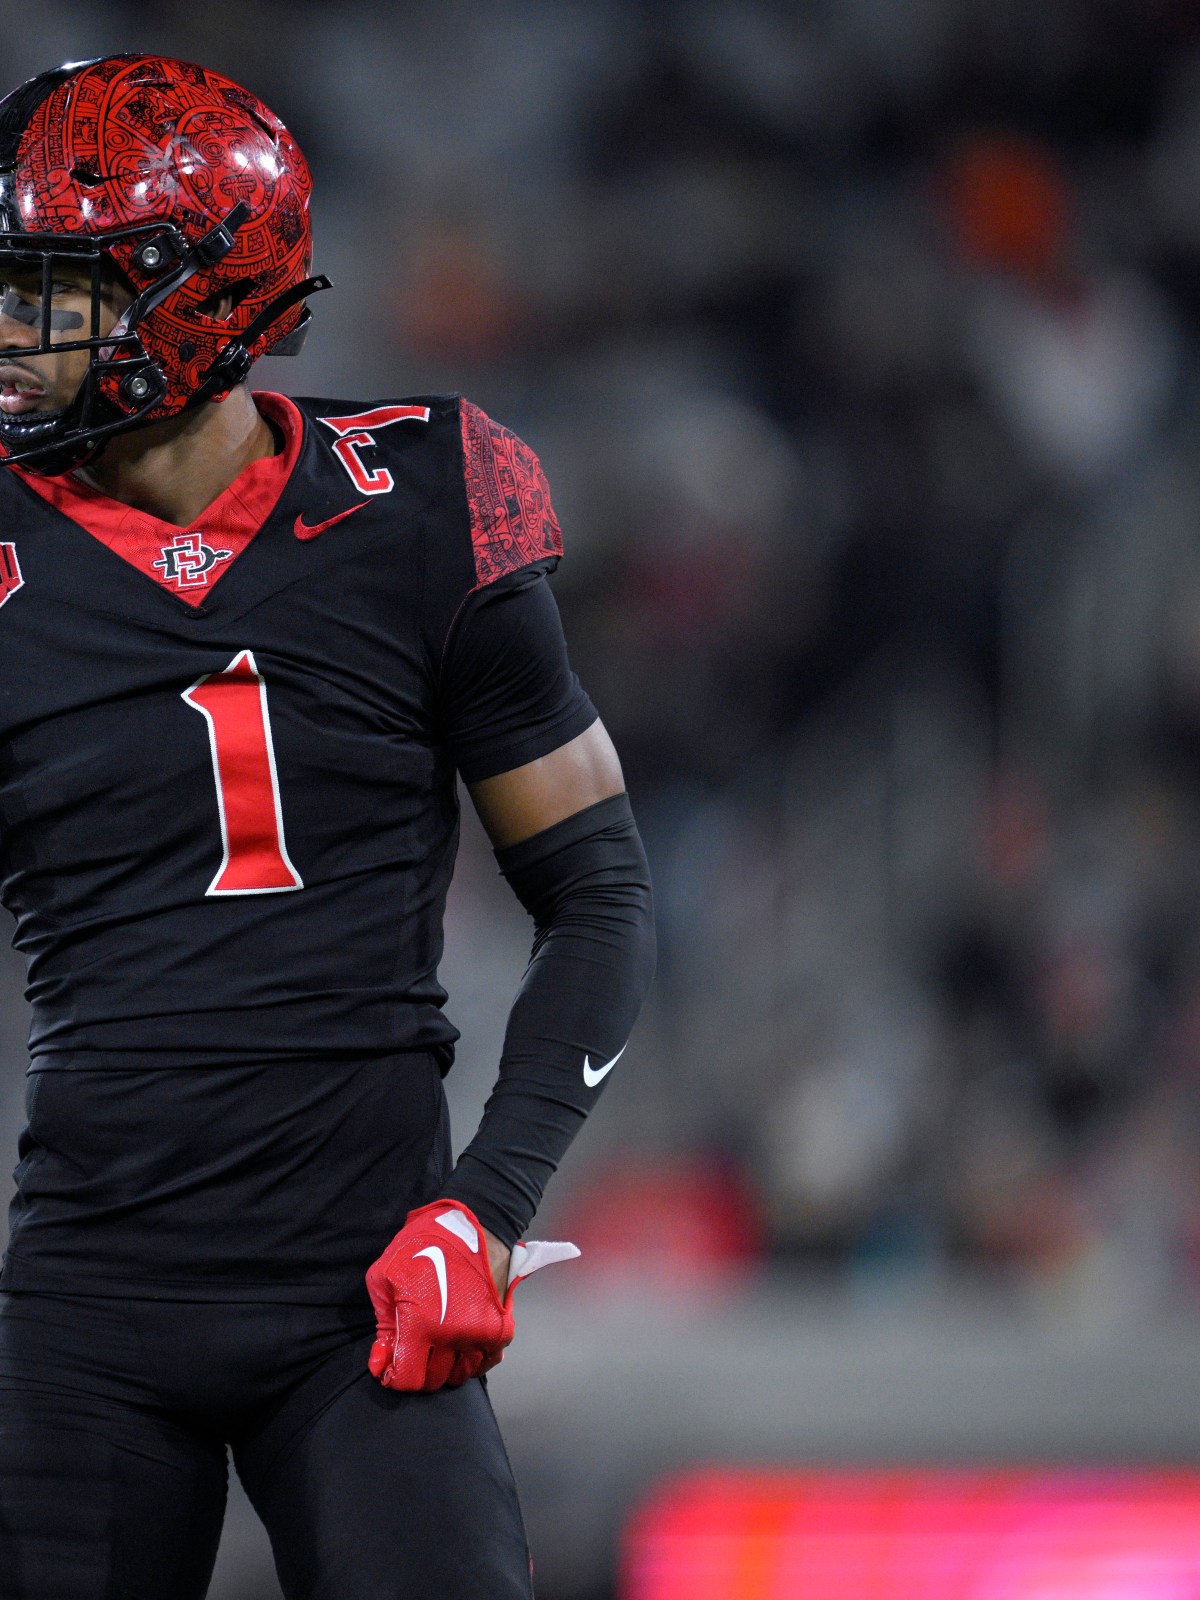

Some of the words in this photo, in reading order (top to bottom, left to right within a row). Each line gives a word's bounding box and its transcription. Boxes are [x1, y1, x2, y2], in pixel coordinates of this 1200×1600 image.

[316, 405, 430, 437] 1
[332, 432, 395, 495] C
[181, 649, 304, 896] 1
